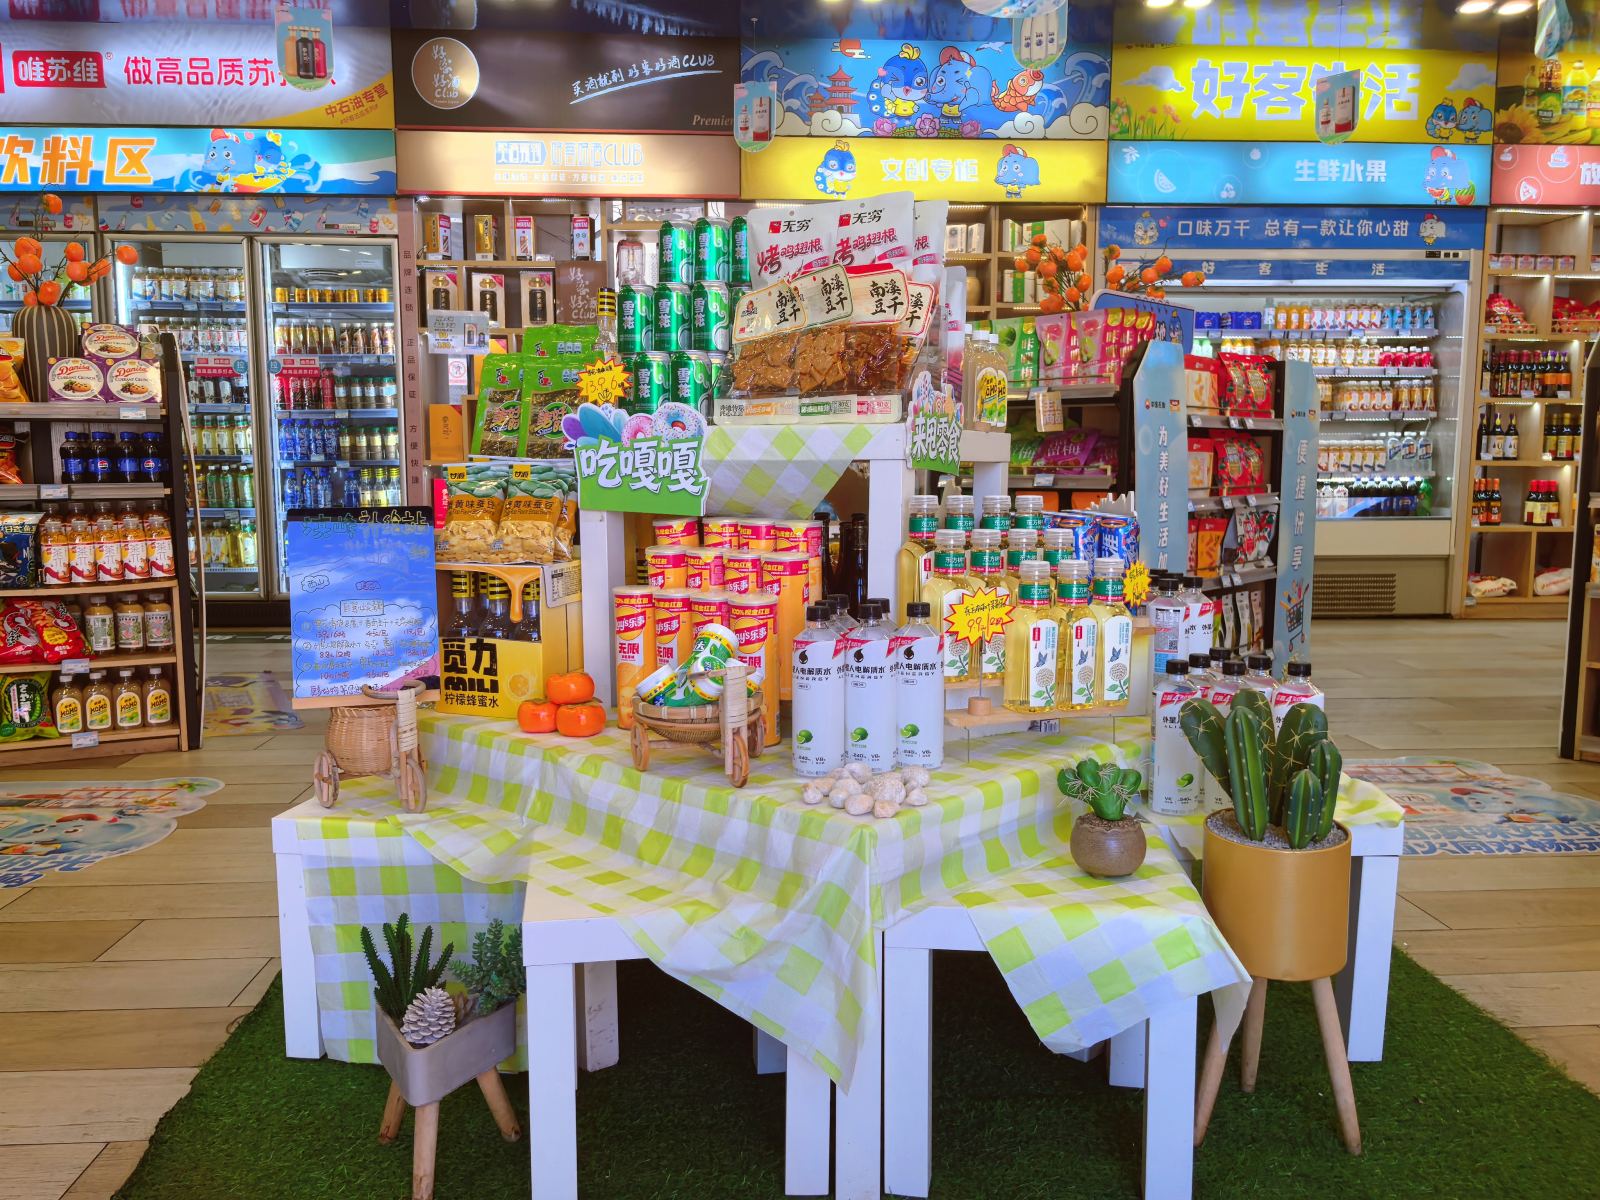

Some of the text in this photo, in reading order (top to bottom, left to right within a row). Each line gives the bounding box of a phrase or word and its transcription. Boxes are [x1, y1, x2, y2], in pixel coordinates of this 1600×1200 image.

[18, 57, 98, 82] 唯苏维
[124, 56, 336, 86] 做高品质苏
[325, 83, 389, 118] 中石油专营
[880, 159, 979, 182] 文创专柜
[1294, 159, 1387, 184] 生鲜水果
[782, 218, 811, 234] 无穷
[852, 209, 883, 225] 无穷
[1178, 218, 1409, 237] 口味万千 总有一款让你心甜
[833, 228, 897, 266] 烤鸡翅根
[757, 238, 823, 276] 烤鸡翅根
[869, 279, 902, 299] 南溪
[825, 294, 848, 315] 豆干
[871, 297, 904, 316] 豆干
[573, 311, 599, 323] Club
[57, 364, 92, 376] Danisa
[115, 366, 148, 378] Danisa
[450, 472, 465, 480] 甘源
[579, 440, 704, 497] 吃嘎嘎
[619, 642, 640, 655] 无限
[444, 692, 500, 708] 柠檬蜂蜜水
